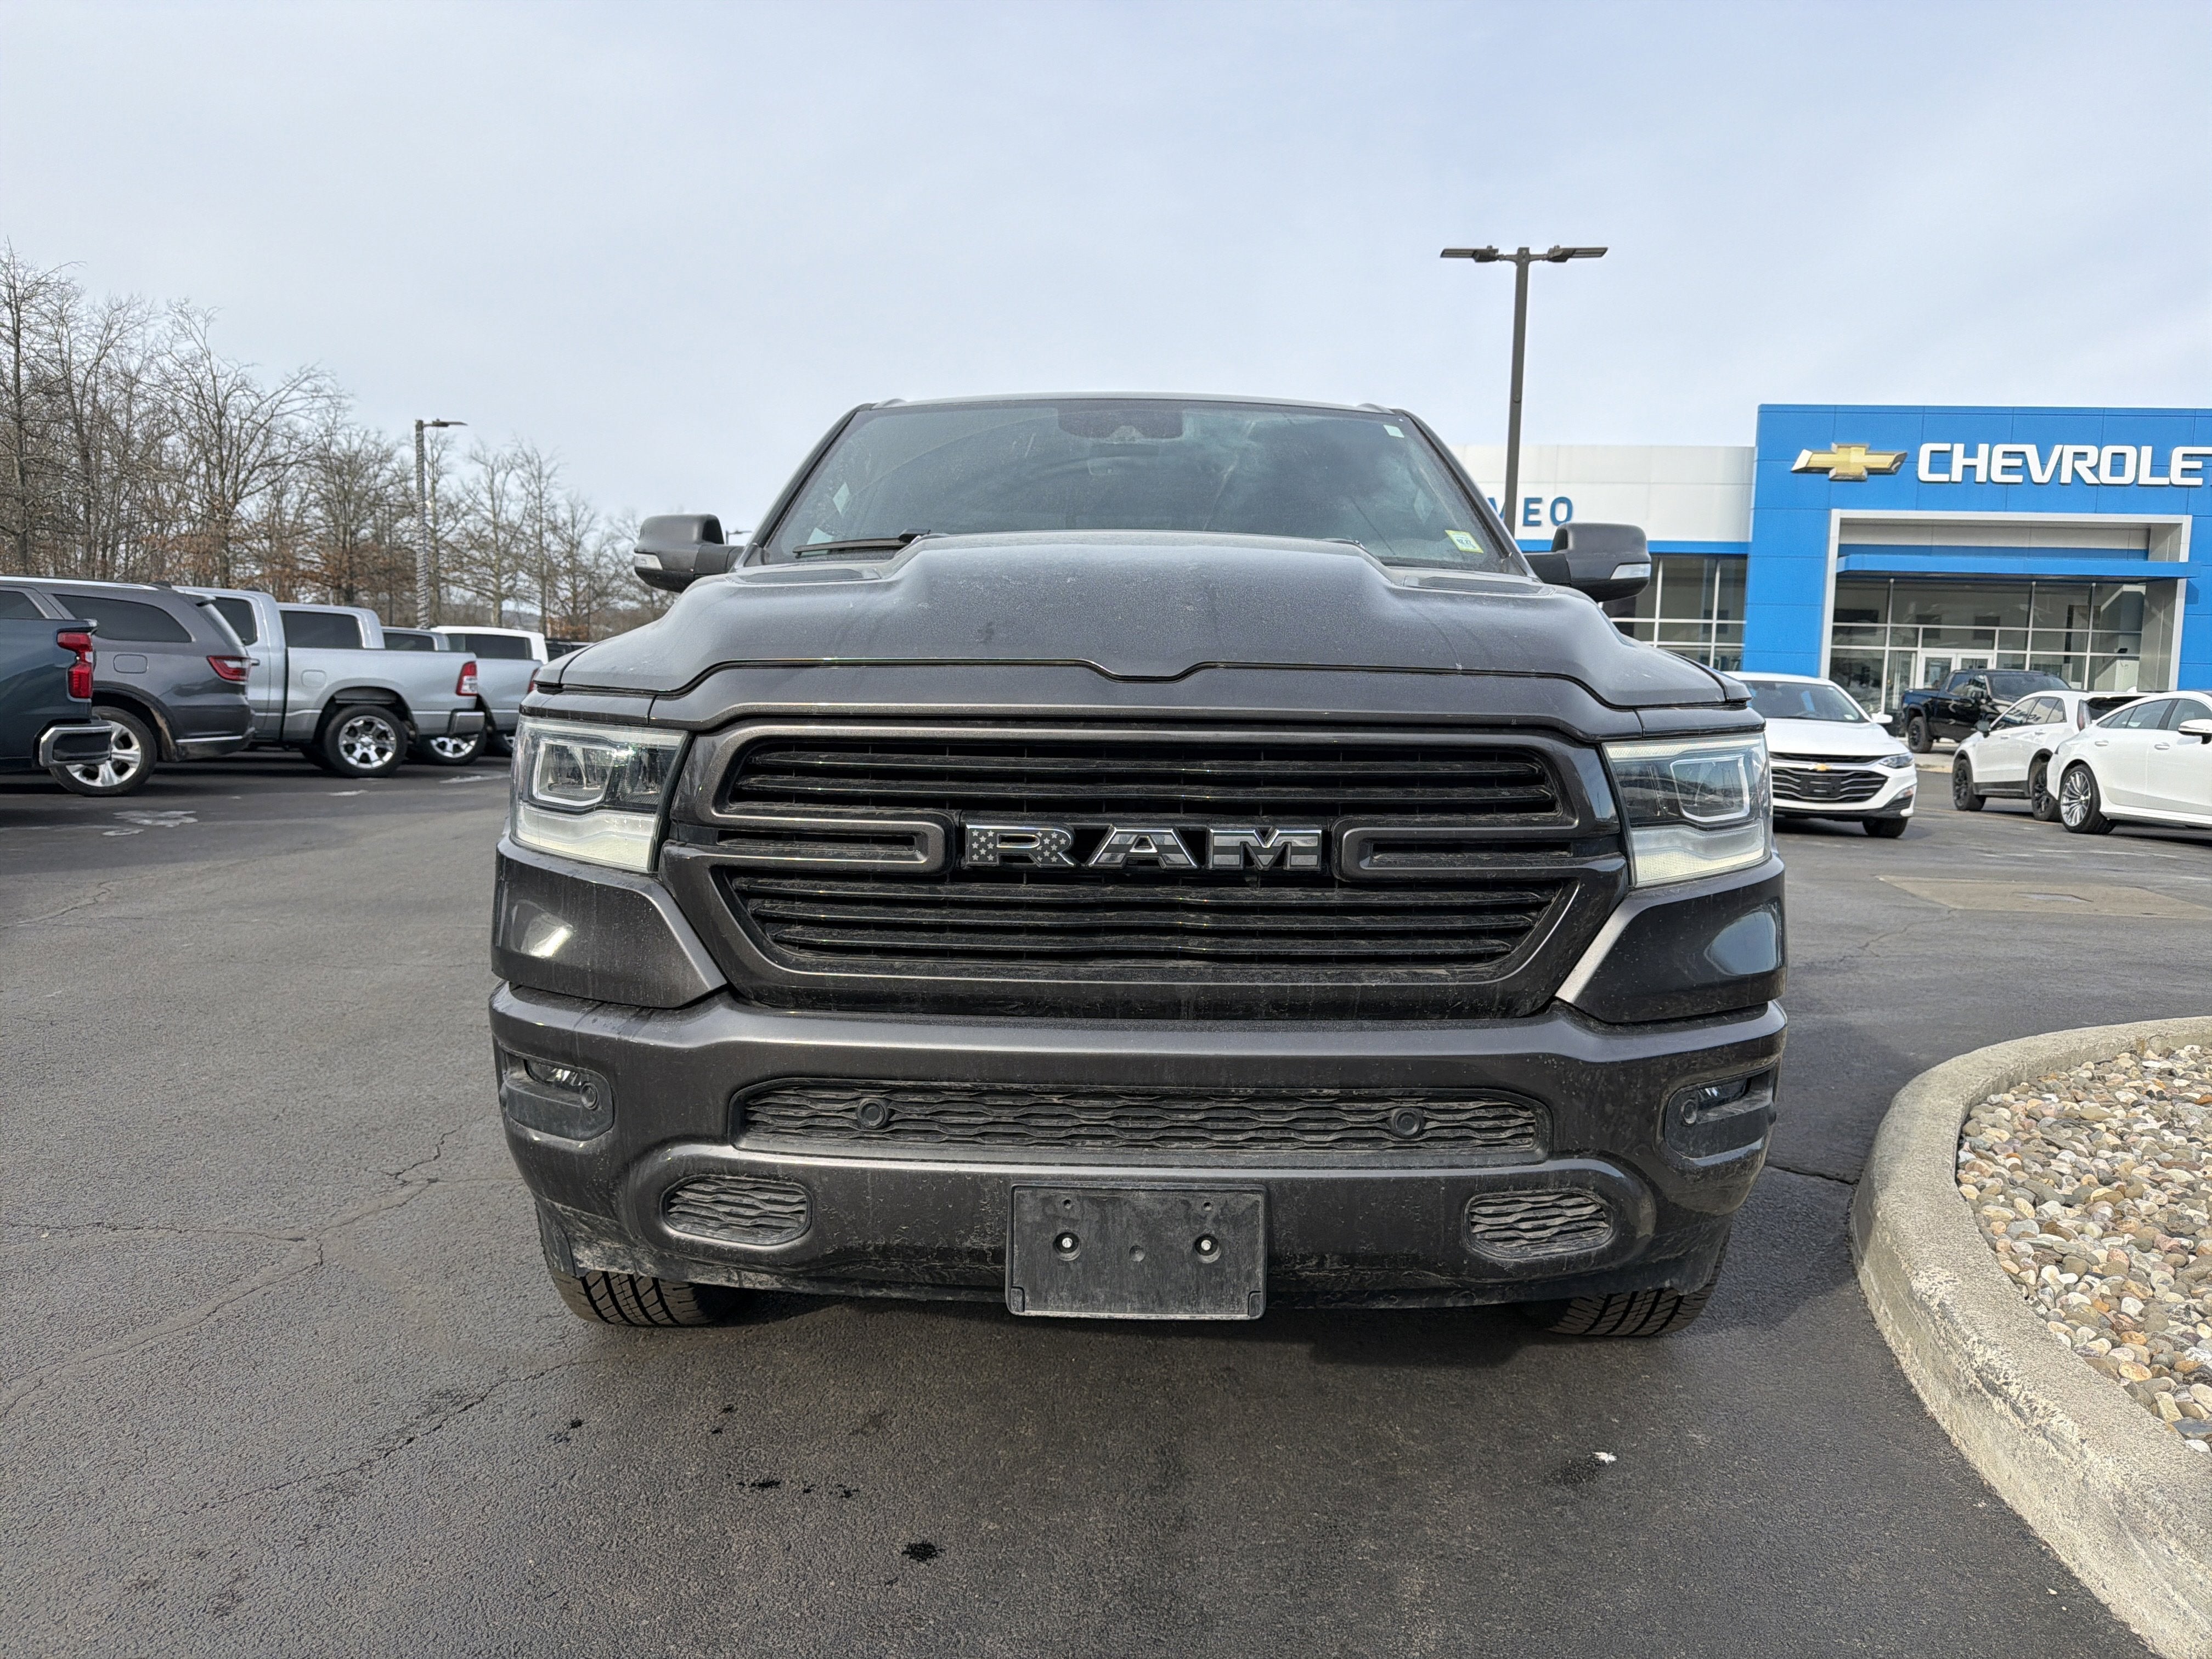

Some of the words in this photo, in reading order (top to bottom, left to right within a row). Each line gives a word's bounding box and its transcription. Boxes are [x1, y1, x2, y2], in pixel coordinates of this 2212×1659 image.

[1918, 443, 2212, 485] CHEVROLE
[1487, 496, 1573, 526] EO
[966, 823, 1323, 870] RAM
